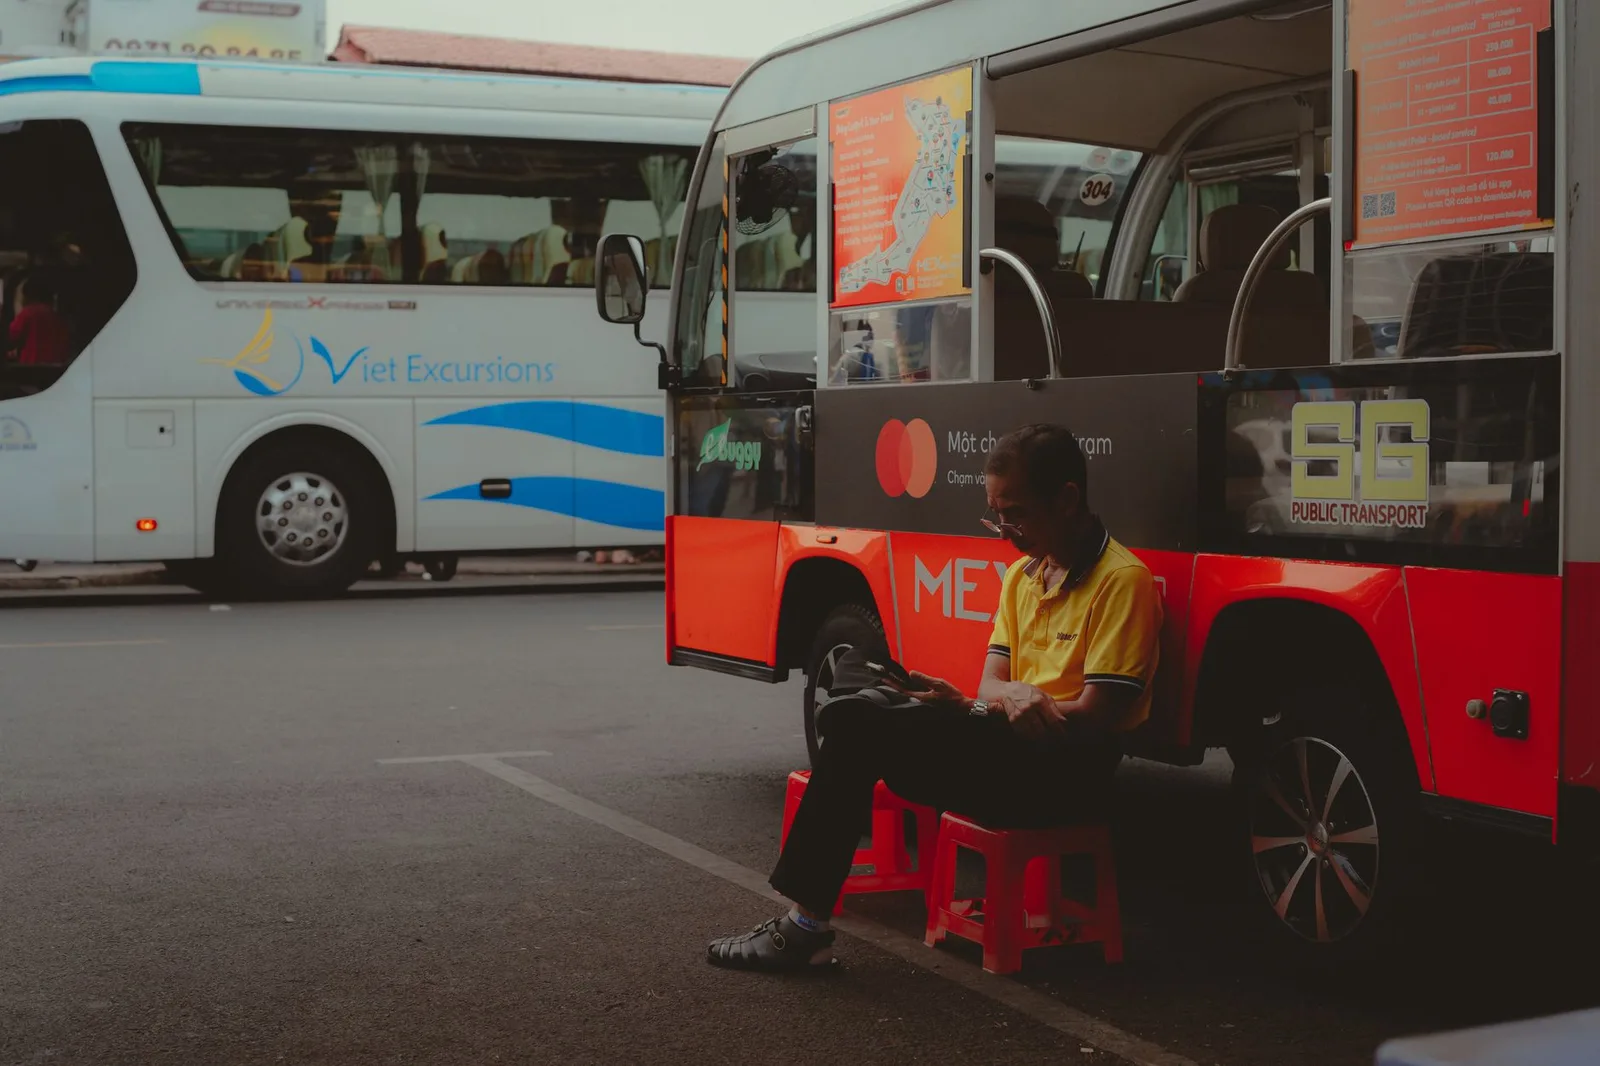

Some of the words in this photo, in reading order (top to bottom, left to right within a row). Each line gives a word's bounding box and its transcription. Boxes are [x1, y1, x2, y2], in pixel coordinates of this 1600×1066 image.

[1082, 180, 1113, 199] 304
[310, 334, 396, 385] Viet
[408, 354, 554, 383] Excursions
[948, 431, 976, 457] Một
[1292, 399, 1430, 501] SG
[947, 470, 973, 487] Chạm
[1292, 502, 1337, 522] PUBLIC
[1341, 503, 1427, 525] TRANSPORT
